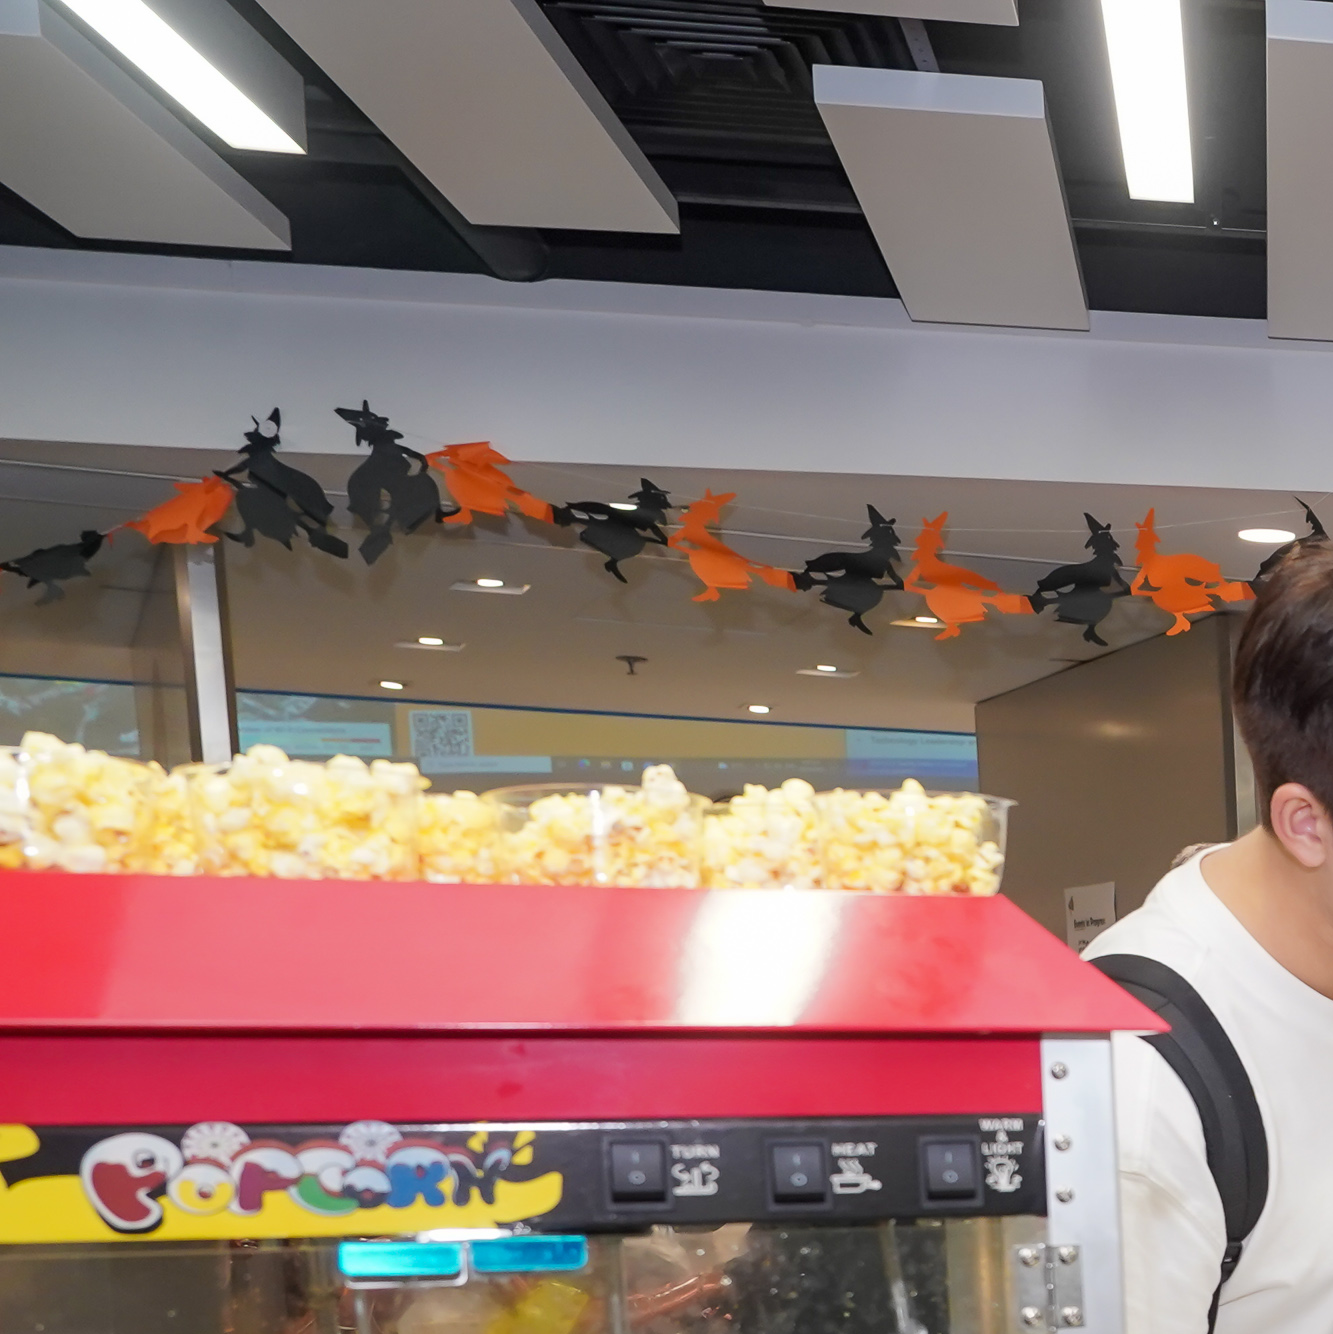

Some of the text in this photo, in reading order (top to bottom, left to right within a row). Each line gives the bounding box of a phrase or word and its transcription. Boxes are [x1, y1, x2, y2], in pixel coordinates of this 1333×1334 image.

[979, 1118, 1024, 1131] WARM
[671, 1144, 720, 1160] TURN
[831, 1142, 879, 1157] HEAT
[981, 1141, 1024, 1156] LIGHT
